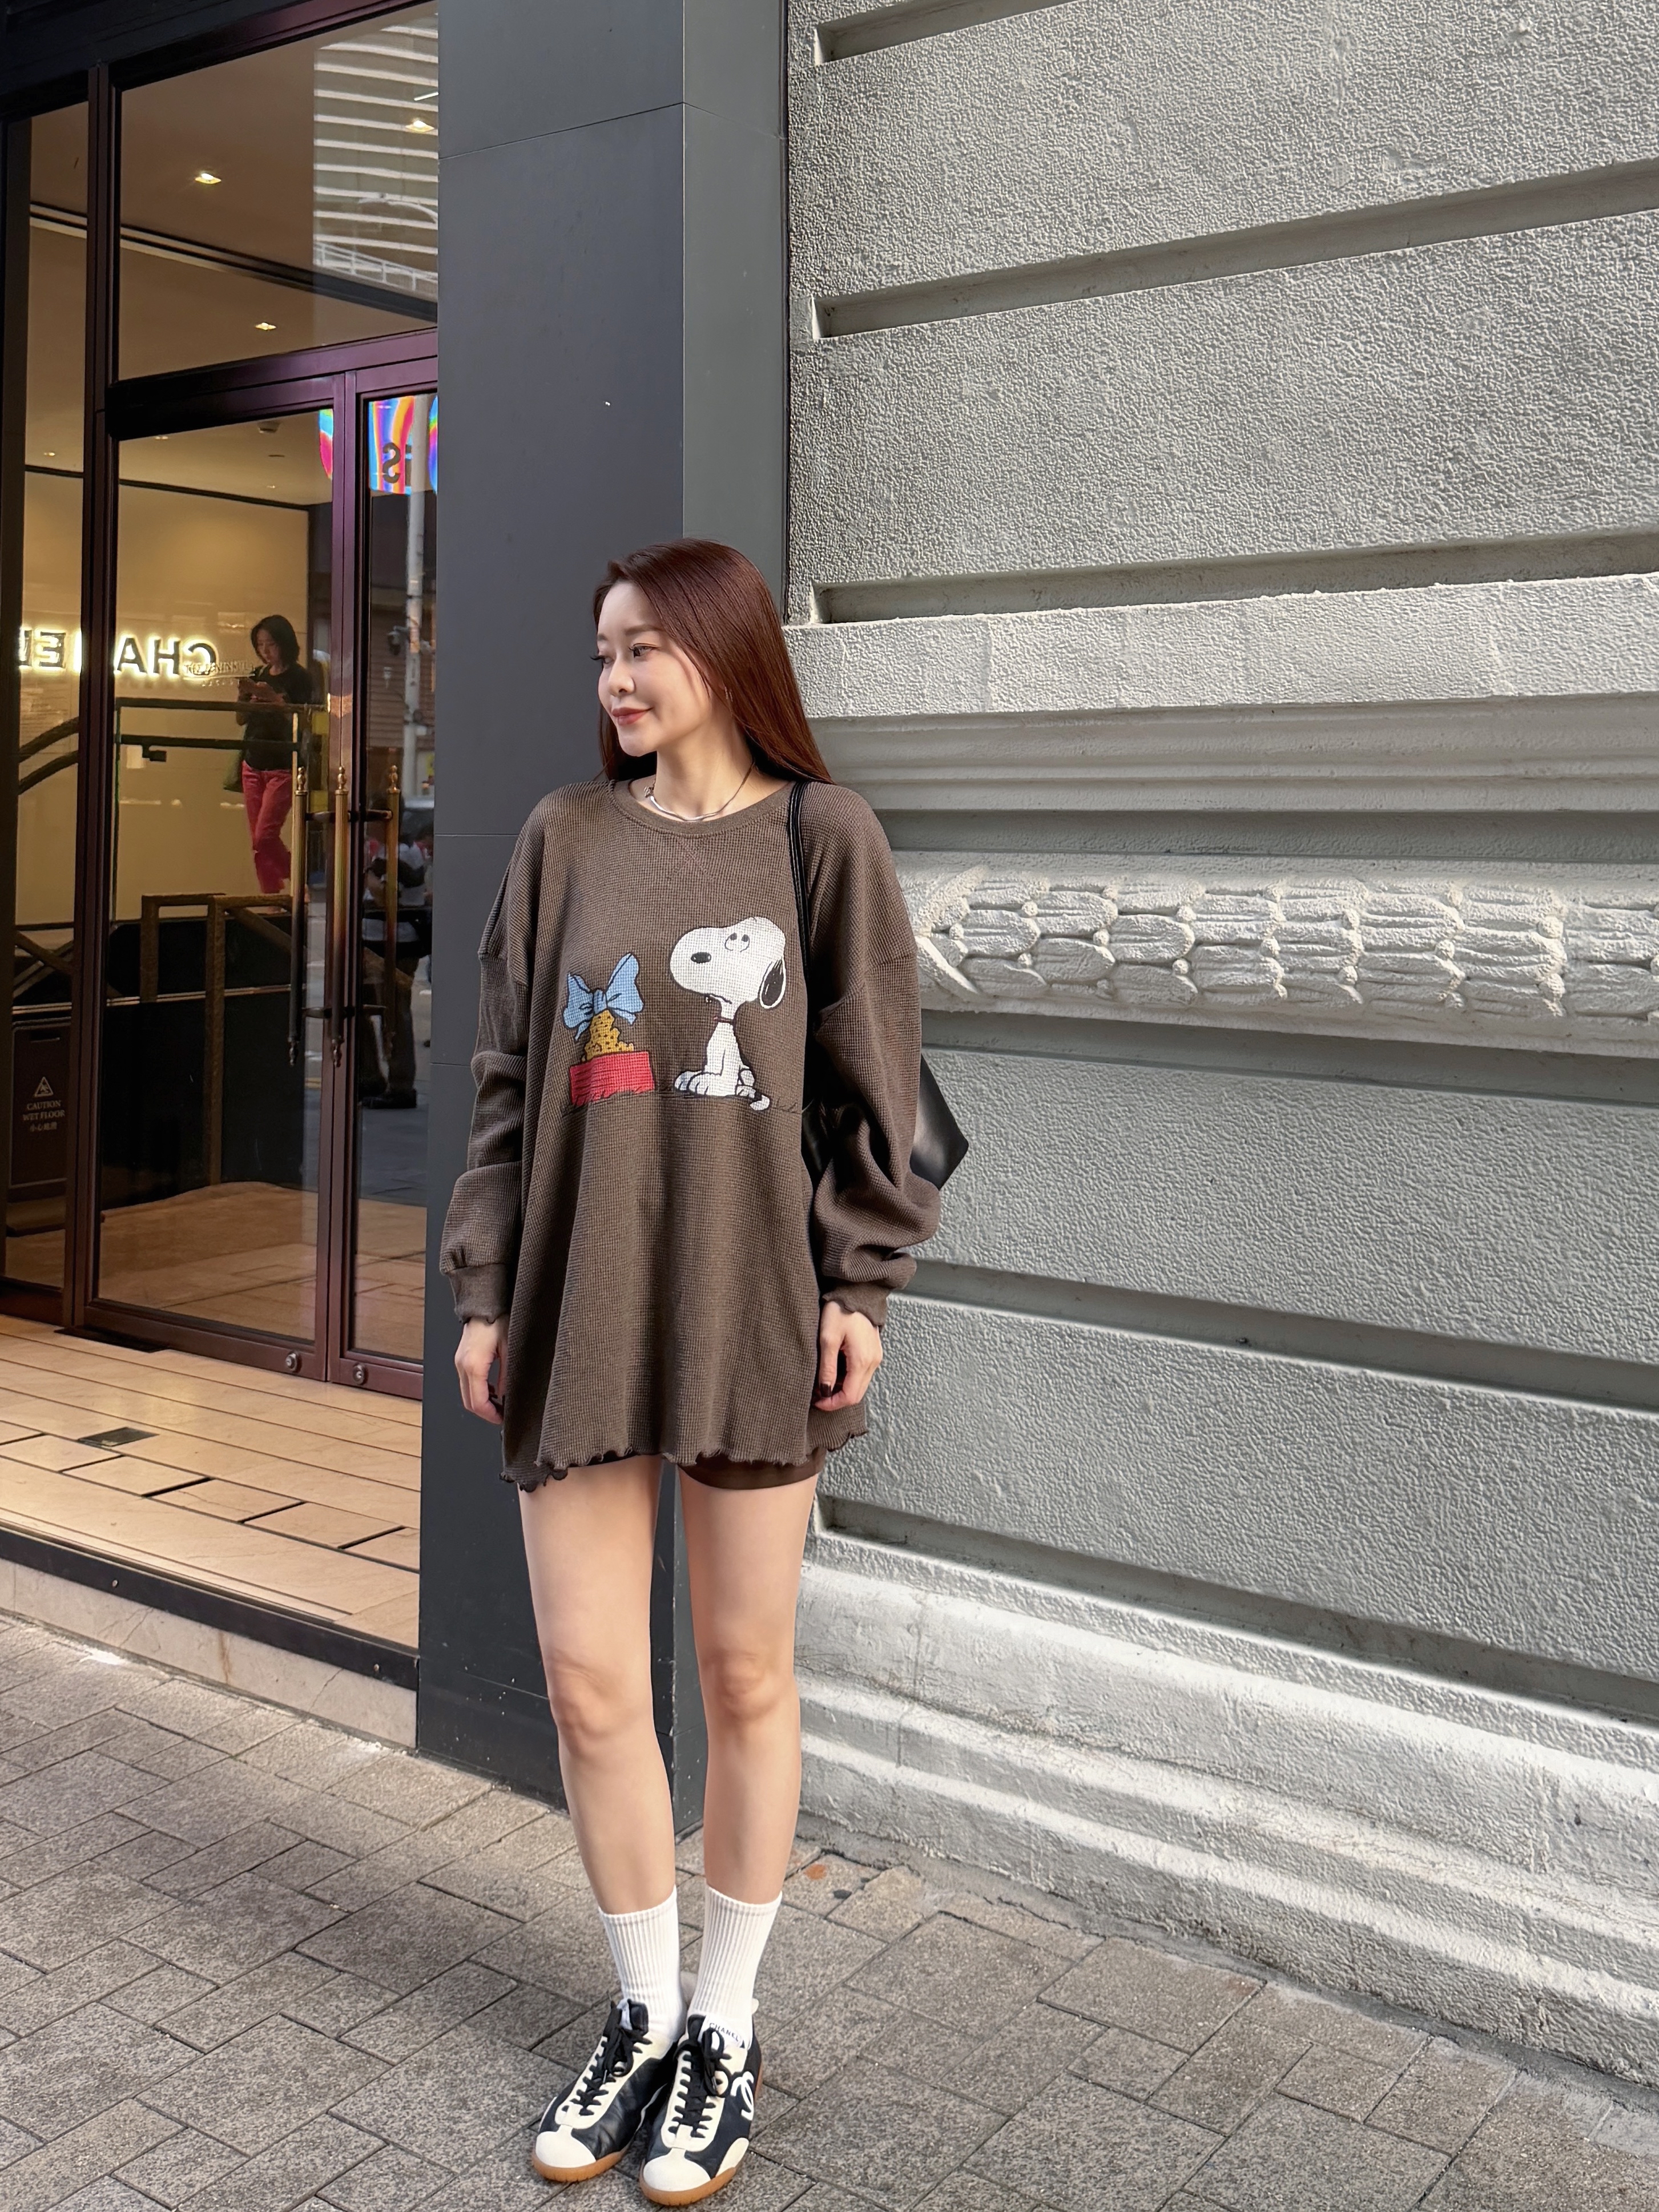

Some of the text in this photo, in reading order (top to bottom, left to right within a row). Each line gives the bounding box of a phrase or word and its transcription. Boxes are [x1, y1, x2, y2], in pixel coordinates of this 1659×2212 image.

[26, 1099, 62, 1111] CAUTION
[22, 1110, 66, 1121] WET FLOOR
